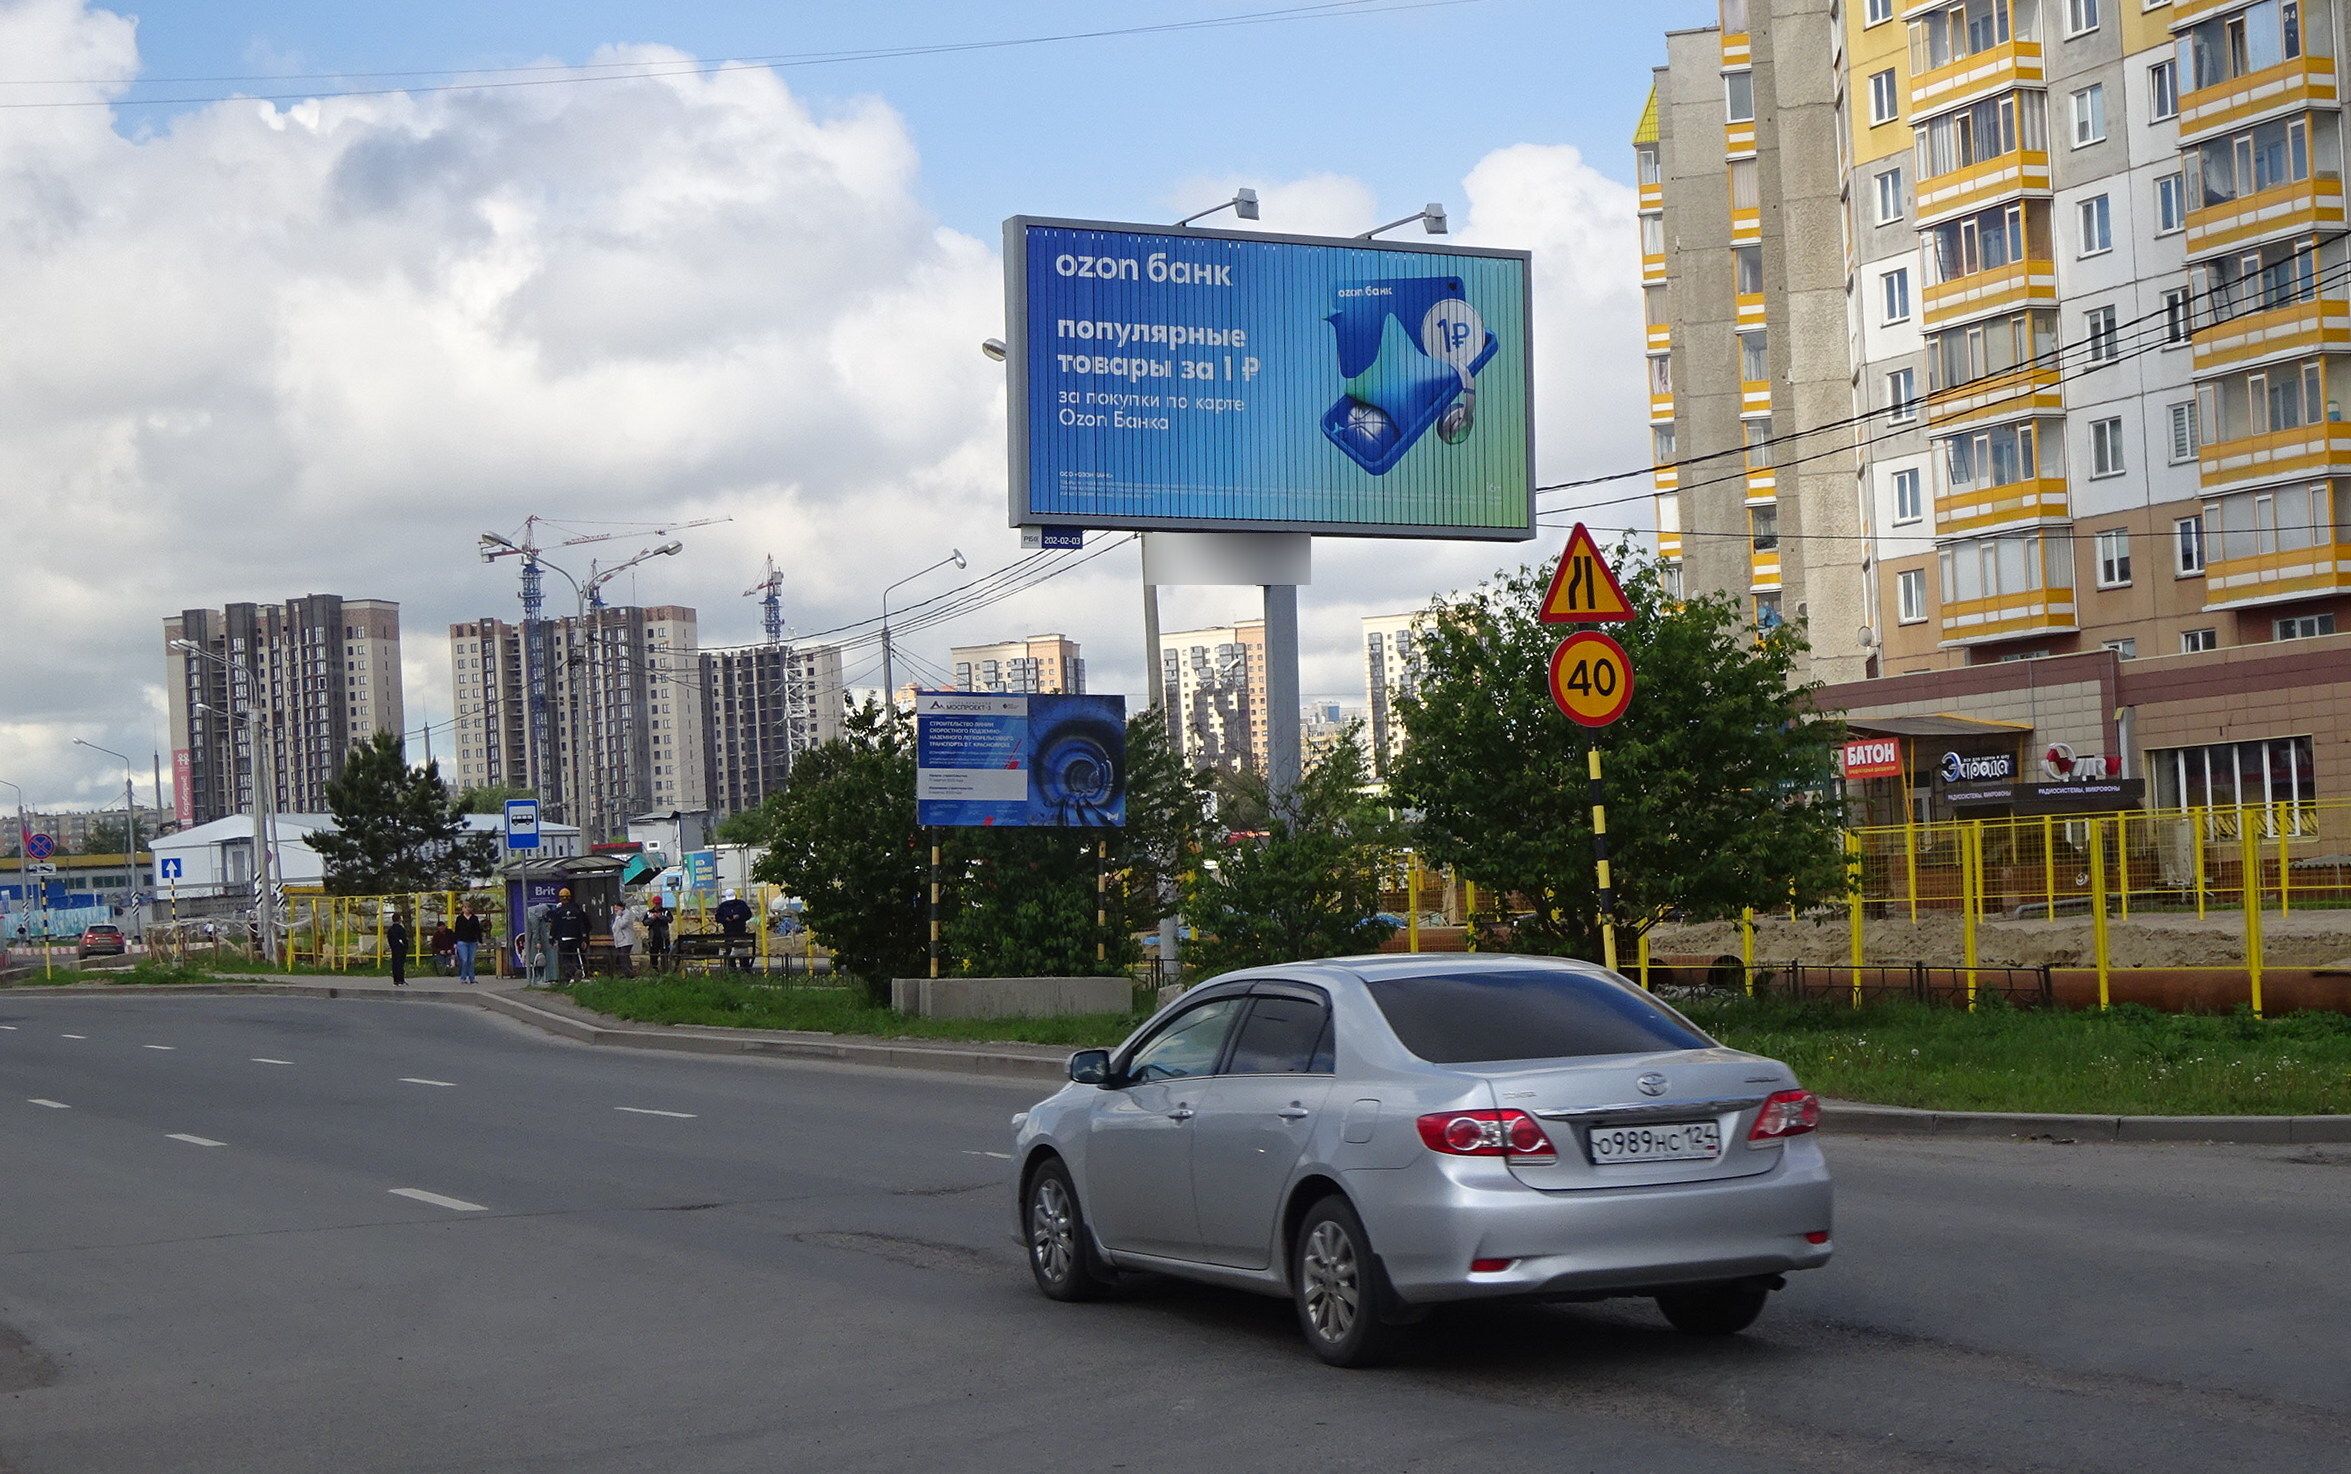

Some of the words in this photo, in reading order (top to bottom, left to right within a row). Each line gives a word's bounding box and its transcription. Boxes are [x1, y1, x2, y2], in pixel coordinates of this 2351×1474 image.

[1056, 254, 1139, 280] ozon
[1148, 253, 1233, 286] банк
[1338, 288, 1363, 297] ozon
[1365, 285, 1392, 296] банк
[1058, 319, 1246, 350] популярные
[1057, 354, 1172, 383] товары
[1181, 360, 1214, 380] за
[1224, 356, 1232, 381] 1
[1058, 391, 1080, 404] за
[1086, 392, 1160, 410] покупки
[1167, 396, 1188, 409] по
[1196, 397, 1245, 414] карте
[1059, 408, 1107, 427] Ozon
[1114, 410, 1169, 429] Банка
[1044, 536, 1080, 545] 202-02-03
[1567, 658, 1616, 697] 40
[1848, 743, 1895, 766] БАТОН
[1941, 752, 2010, 782] Эстрада
[2038, 787, 2084, 795] РАДИОСИСТЕМЫ,
[535, 886, 556, 896] Brit
